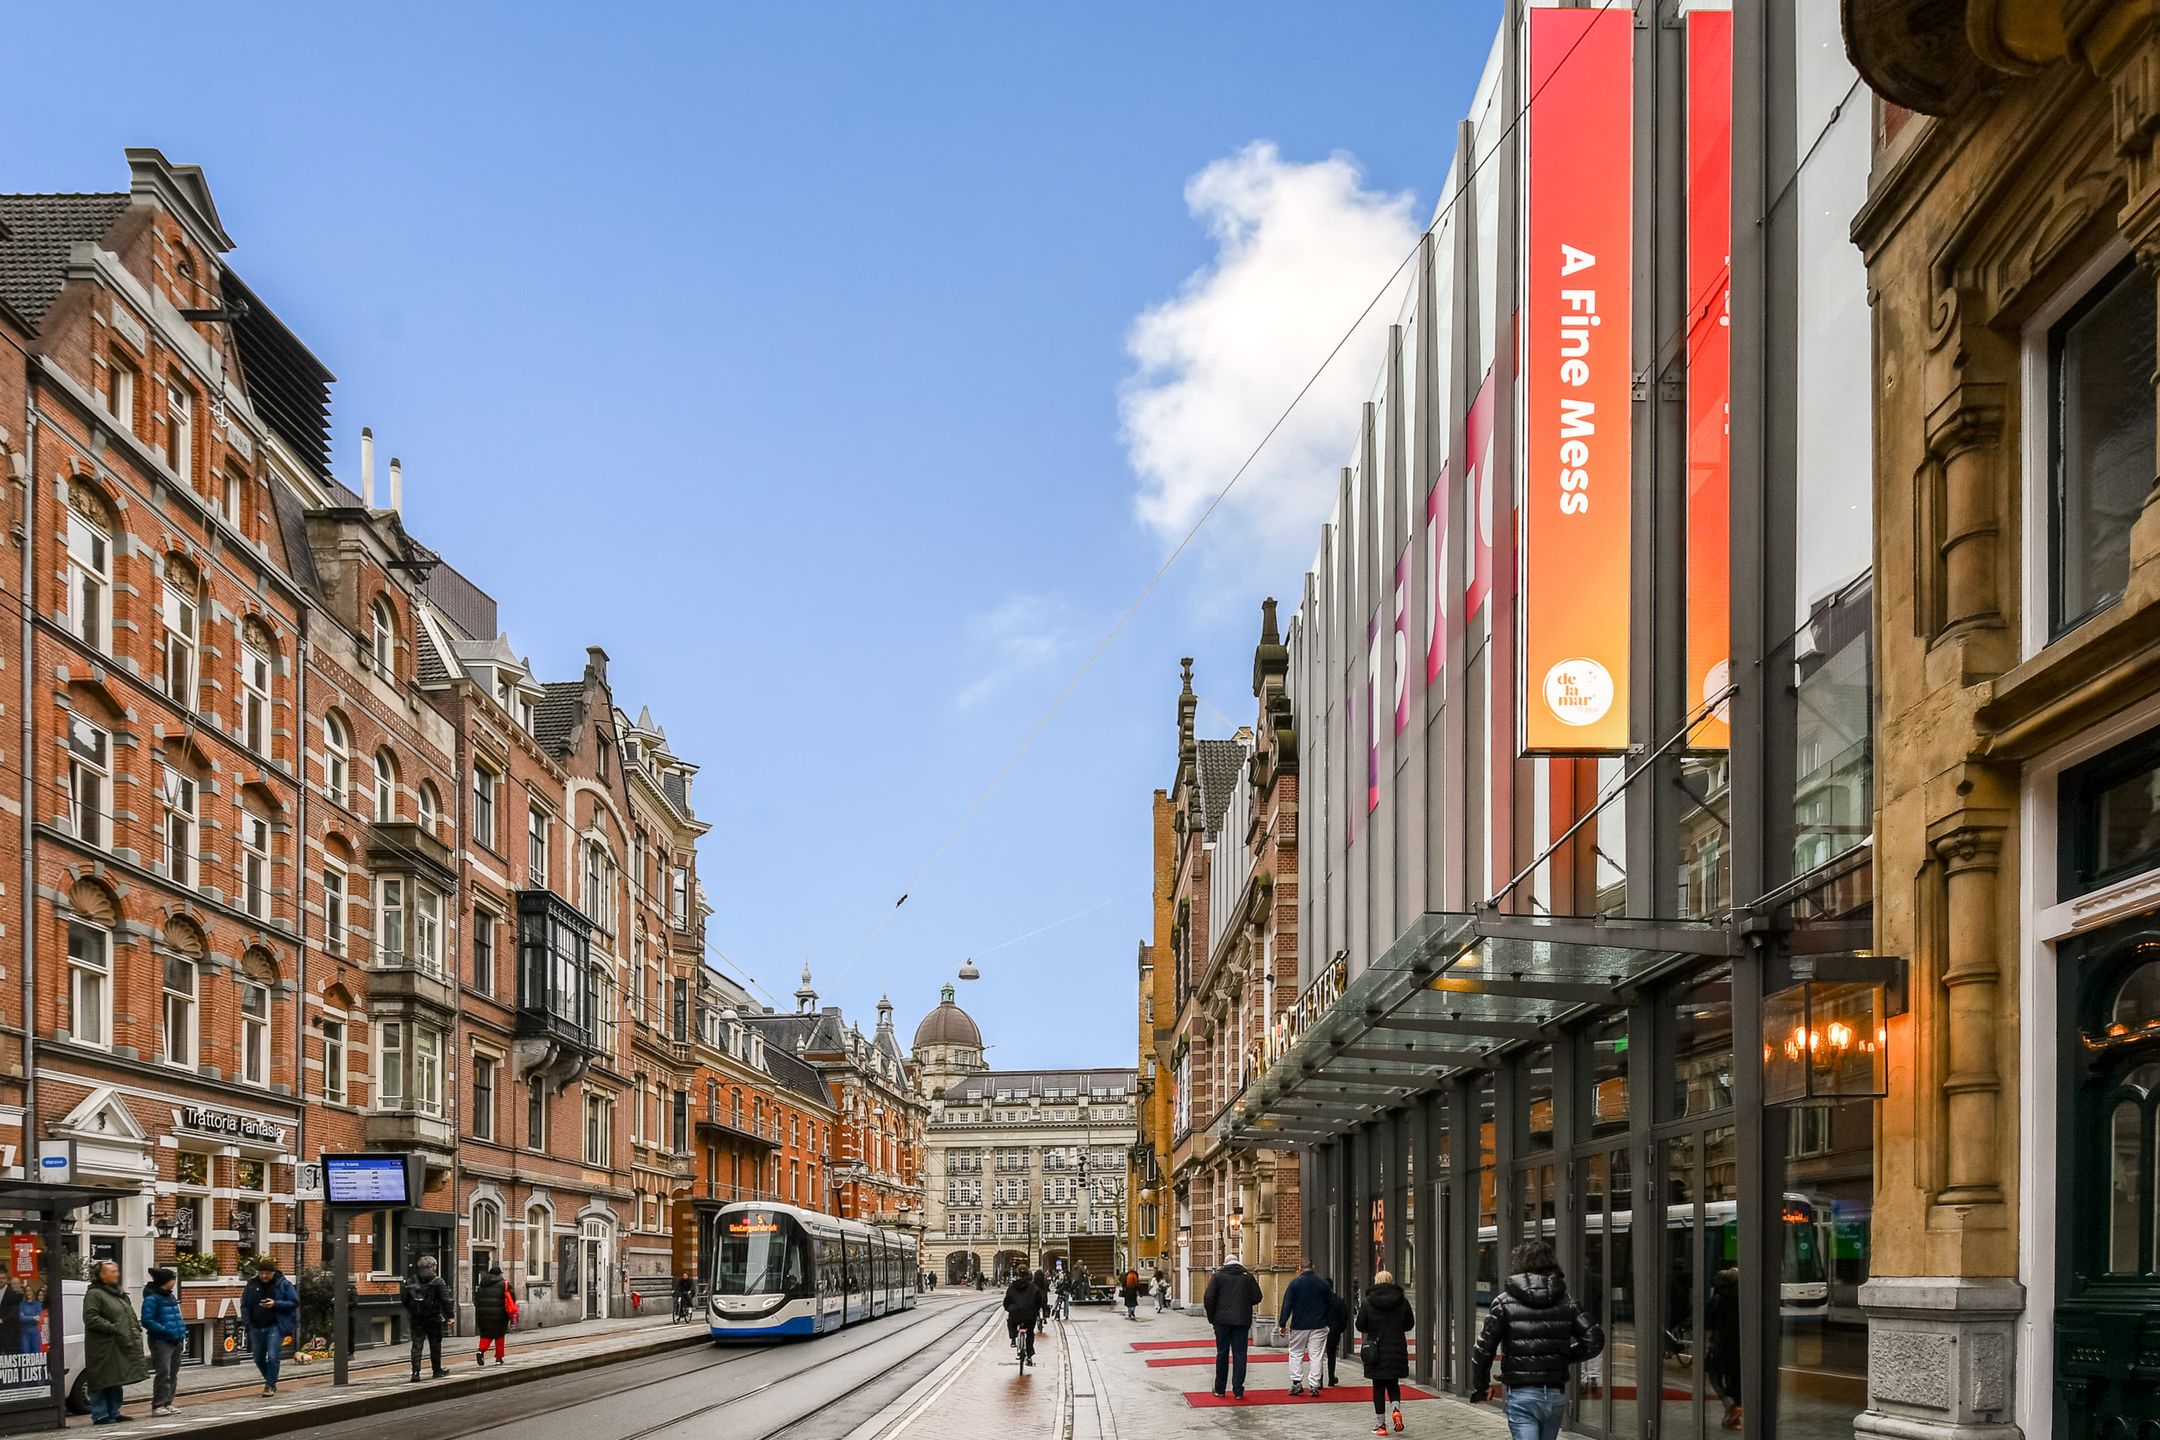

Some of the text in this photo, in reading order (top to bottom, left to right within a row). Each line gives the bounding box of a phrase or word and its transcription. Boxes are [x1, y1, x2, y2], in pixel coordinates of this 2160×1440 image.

[1559, 243, 1601, 515] A Fine Mess
[1557, 672, 1577, 685] de
[1565, 685, 1579, 696] la
[1558, 696, 1590, 706] mar
[1293, 961, 1342, 1039] THEATER
[186, 1107, 282, 1138] Trattoria Fantasia
[0, 1352, 47, 1368] AMSTERDAM
